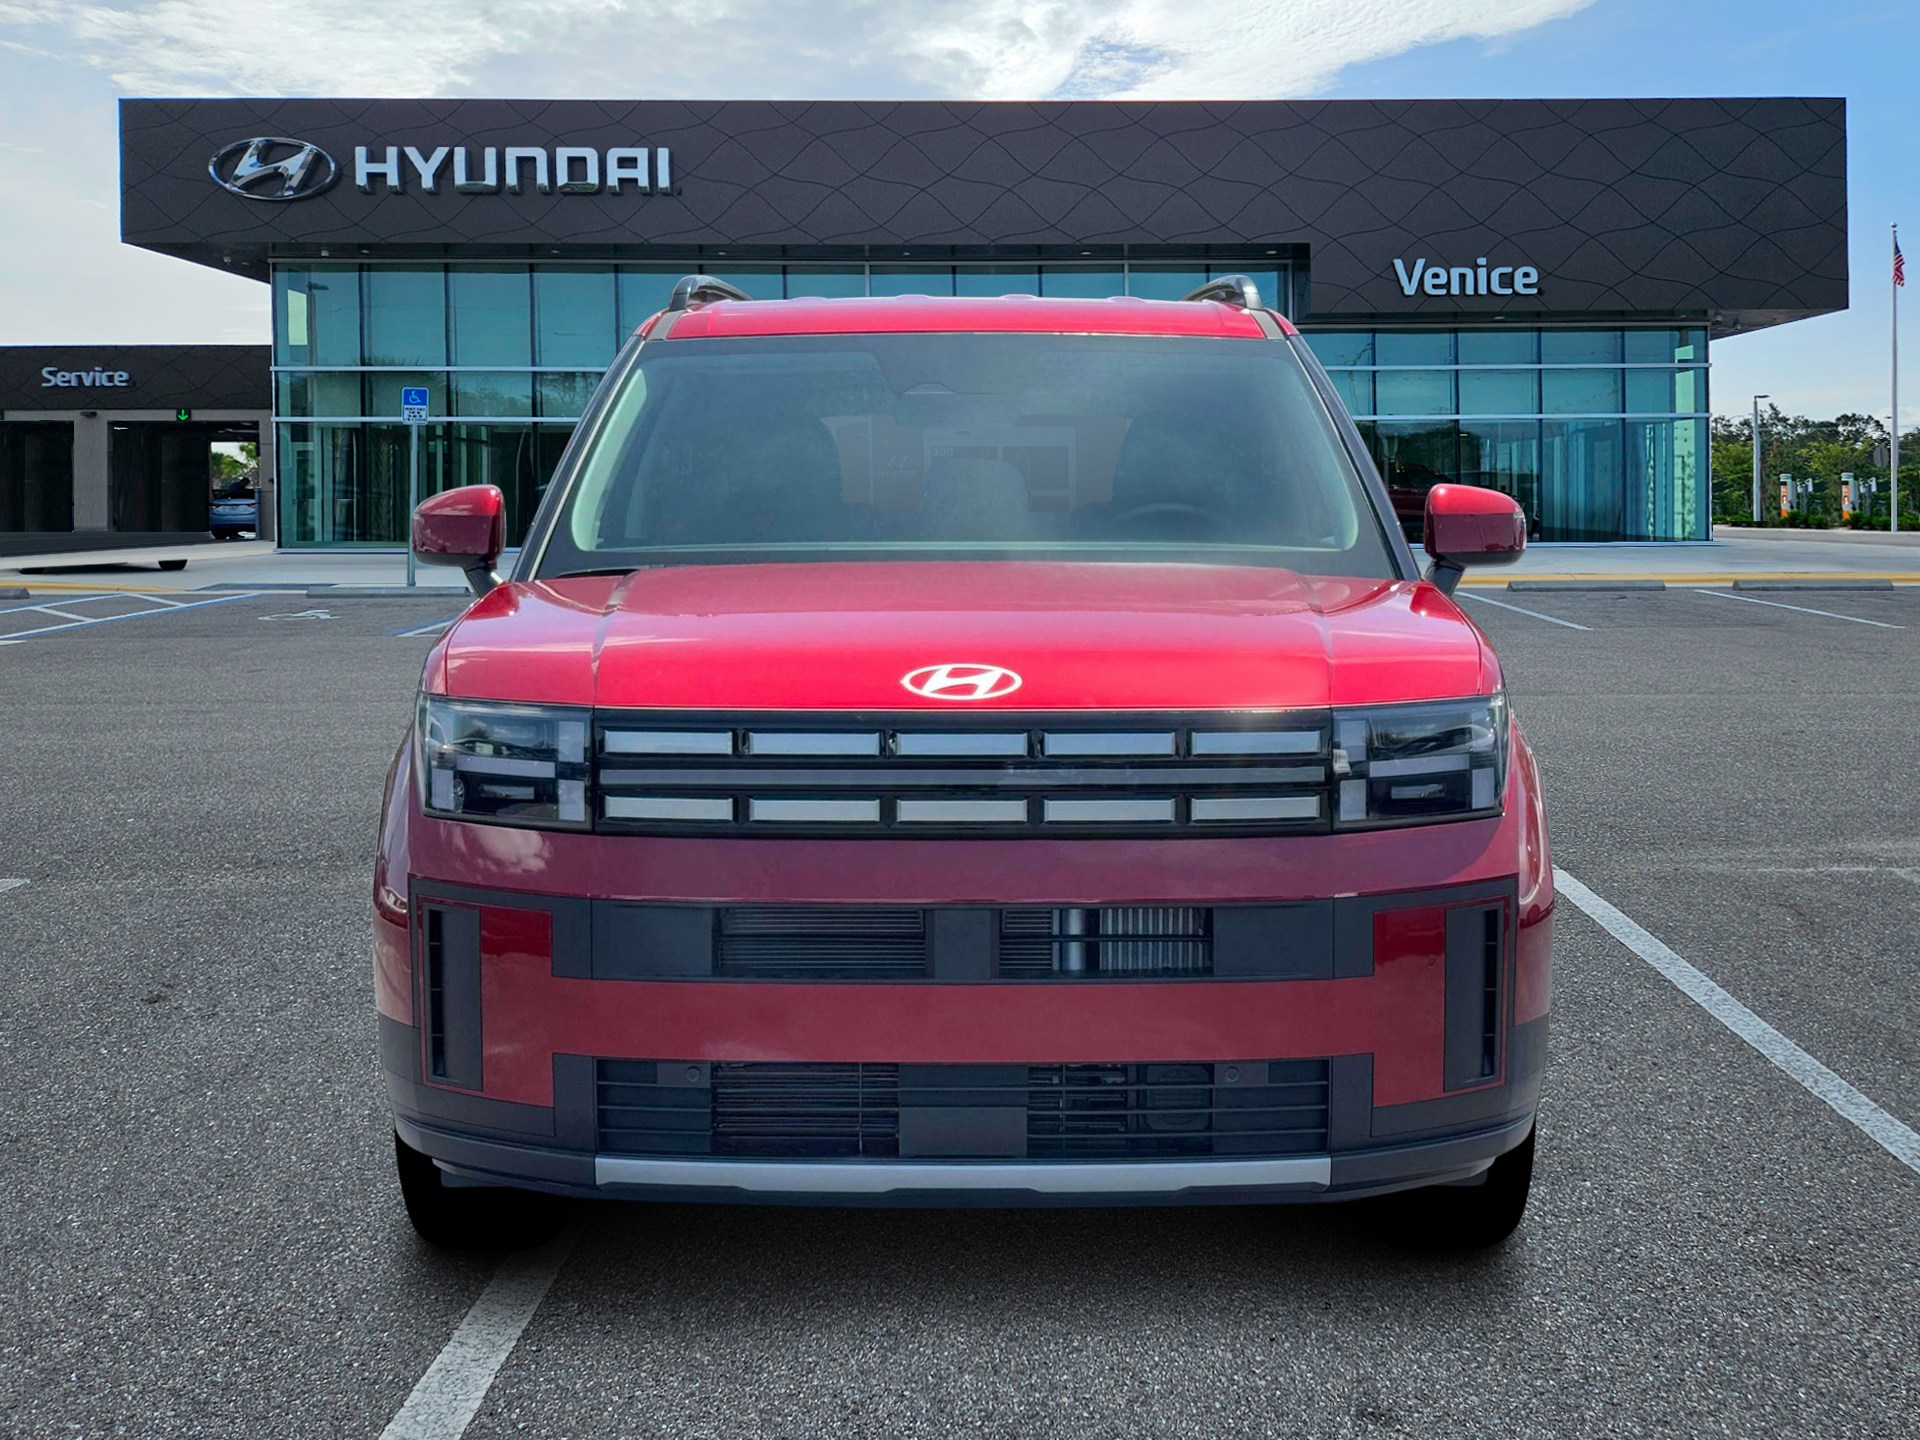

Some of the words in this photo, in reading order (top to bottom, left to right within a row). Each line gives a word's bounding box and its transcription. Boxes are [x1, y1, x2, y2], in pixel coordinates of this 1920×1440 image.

[354, 146, 673, 194] HYUNDAI
[1393, 257, 1539, 295] Venice
[41, 366, 130, 387] Service
[932, 446, 954, 457] 200
